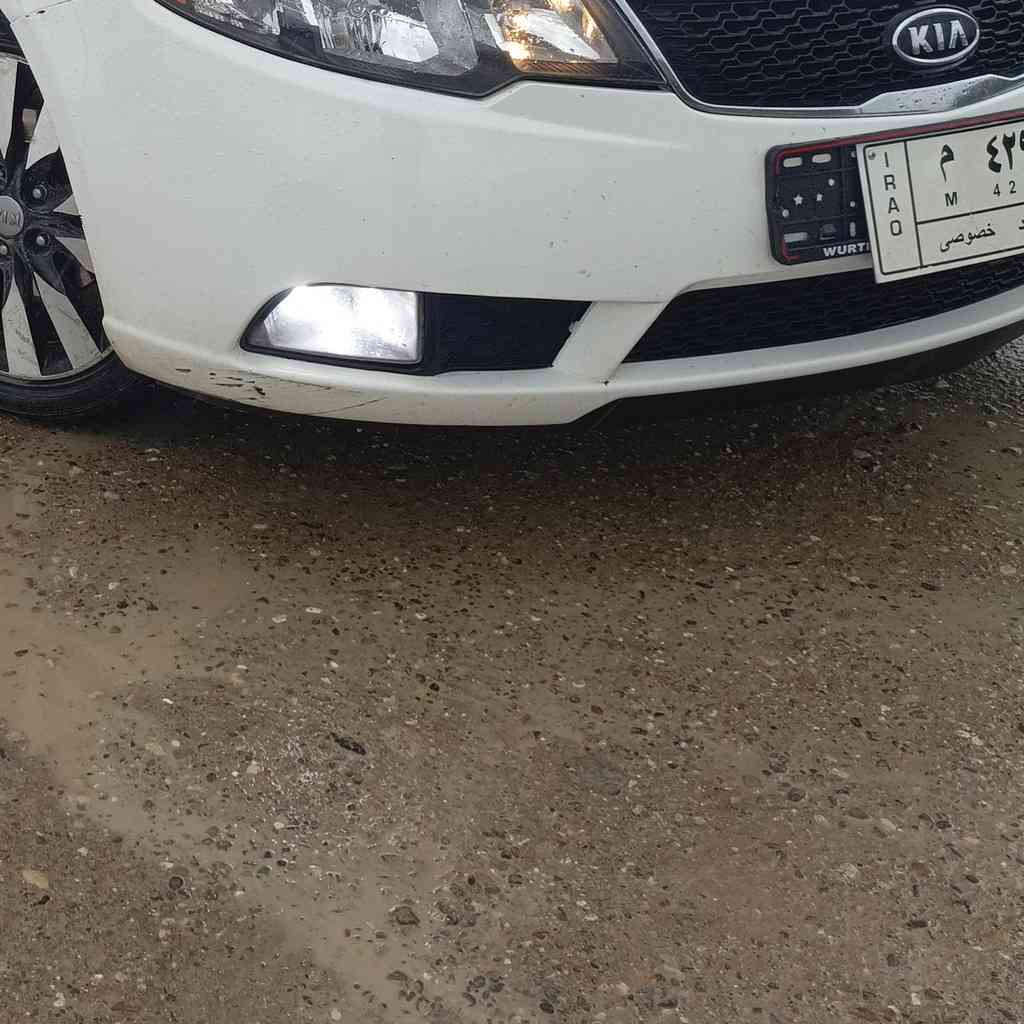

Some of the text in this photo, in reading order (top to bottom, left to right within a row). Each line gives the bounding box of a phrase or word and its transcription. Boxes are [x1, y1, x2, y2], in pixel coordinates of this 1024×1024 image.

[908, 19, 969, 56] KIA
[882, 151, 903, 237] IRAQ
[944, 180, 1017, 207] M 42
